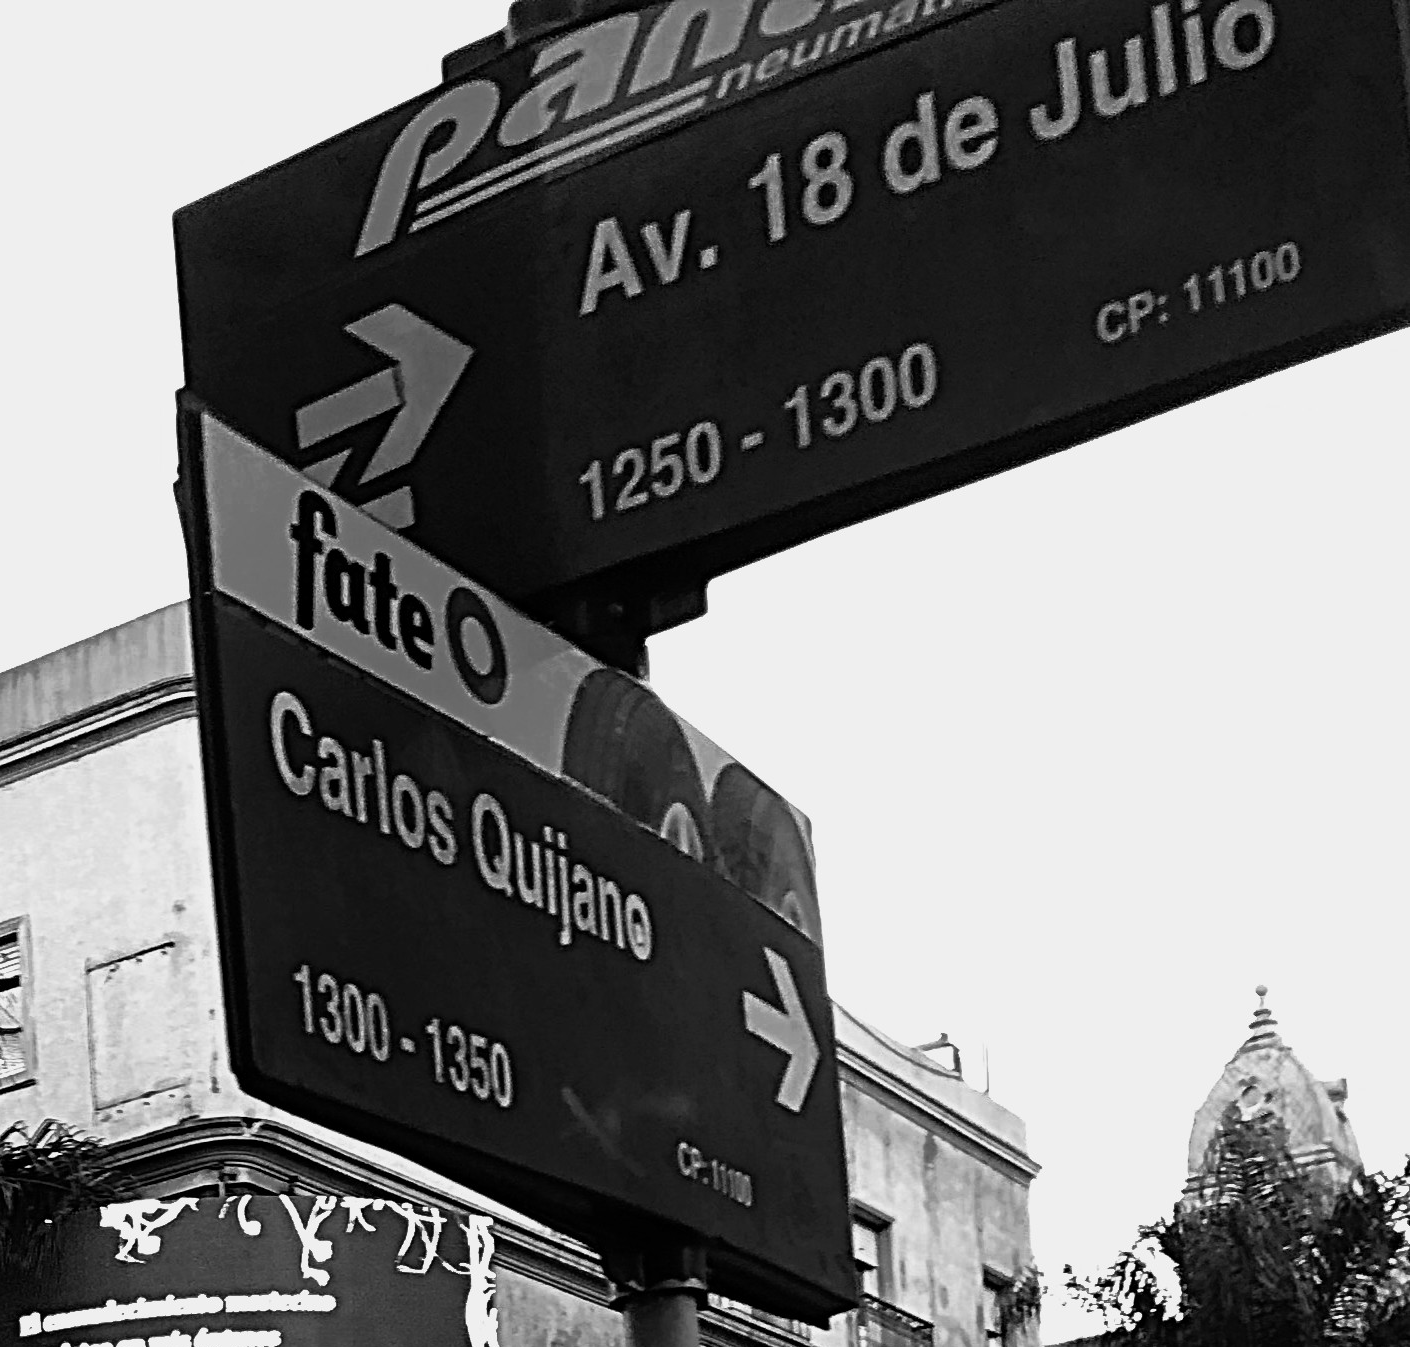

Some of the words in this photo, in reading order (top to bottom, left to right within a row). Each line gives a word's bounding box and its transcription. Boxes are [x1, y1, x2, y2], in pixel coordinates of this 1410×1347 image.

[579, 209, 719, 315] Av.
[748, 132, 853, 243] 18
[883, 90, 1000, 194] de
[1030, 0, 1276, 141] Julio
[1096, 290, 1169, 343] CP:
[1183, 241, 1301, 312] 11100
[579, 421, 722, 519] 1250
[784, 342, 938, 448] 1300
[270, 690, 458, 866] Carlos
[472, 793, 653, 961] Quijano
[293, 964, 389, 1062] 1300
[426, 1018, 512, 1108] 1350
